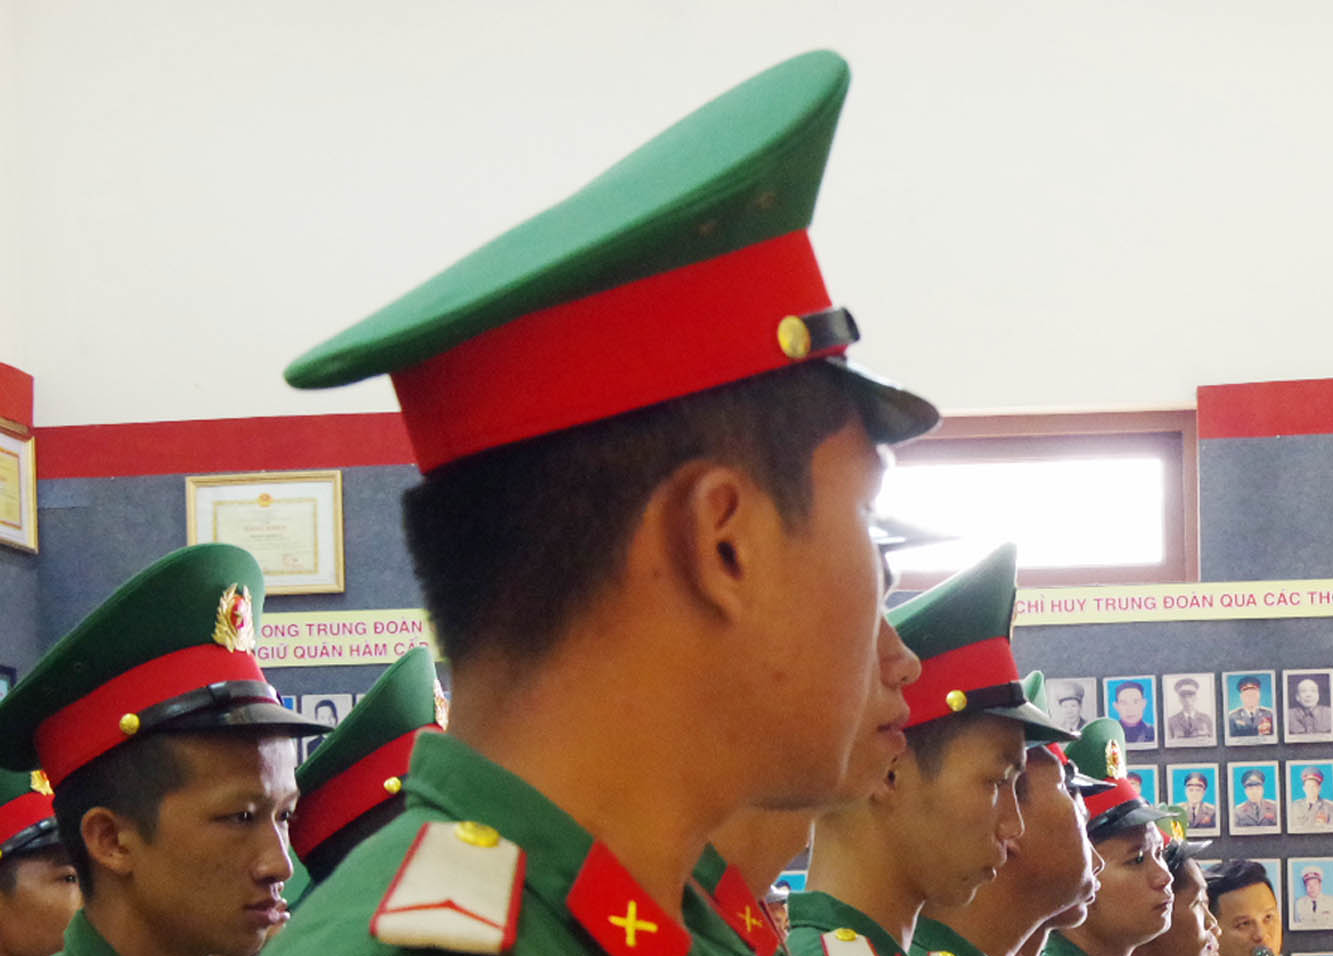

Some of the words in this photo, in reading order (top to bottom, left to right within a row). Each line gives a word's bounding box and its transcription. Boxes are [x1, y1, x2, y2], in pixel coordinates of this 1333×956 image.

[1051, 598, 1086, 613] HUY
[1094, 597, 1157, 612] TRUNG
[1163, 590, 1214, 610] ĐOÀN
[1220, 593, 1257, 608] QUA
[1263, 588, 1301, 607] CÁC
[306, 621, 367, 637] TRUNG
[374, 616, 423, 635] ĐOÀN
